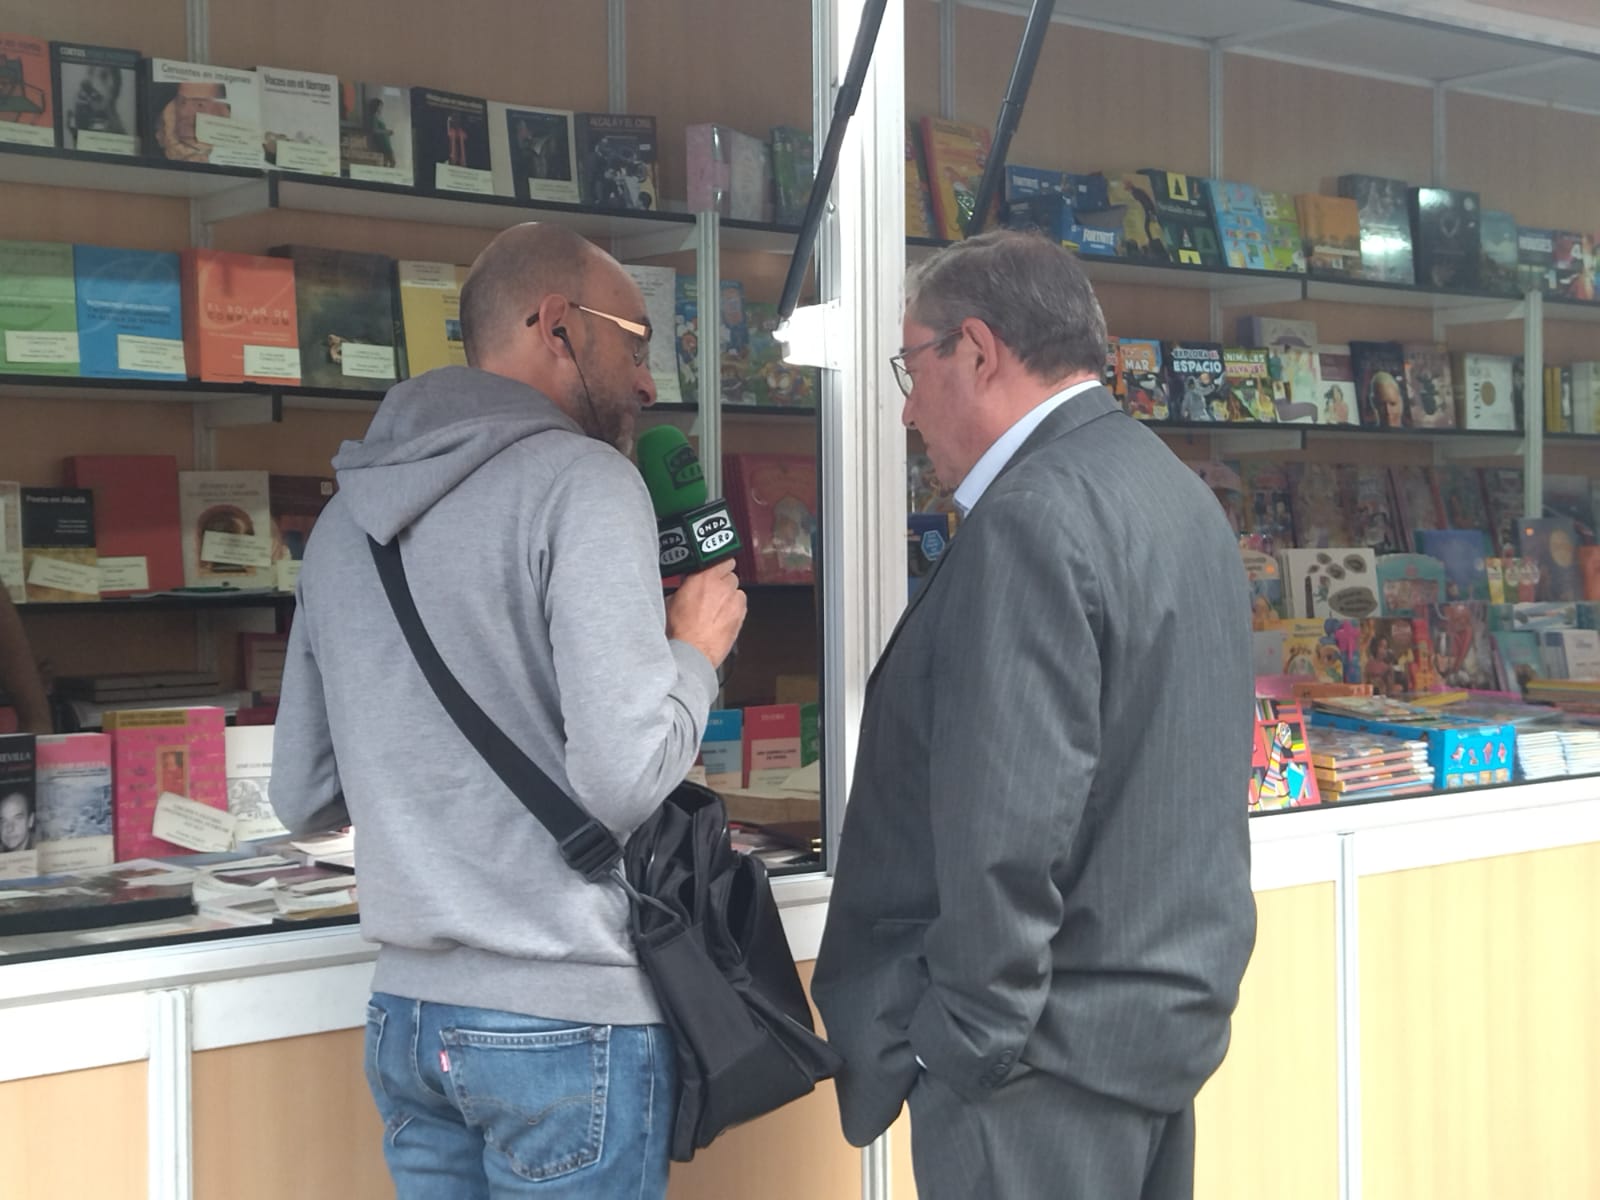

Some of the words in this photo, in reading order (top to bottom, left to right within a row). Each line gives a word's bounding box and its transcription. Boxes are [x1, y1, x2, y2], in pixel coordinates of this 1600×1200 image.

[207, 302, 221, 312] EL
[227, 304, 269, 316] SOLAR
[273, 309, 289, 319] DE
[207, 311, 289, 326] COMPLUTUM
[1224, 352, 1265, 363] ANIMALES
[1124, 359, 1149, 371] MAR
[1173, 360, 1222, 373] ESPACIO
[698, 519, 726, 536] ONDA
[705, 532, 730, 549] CERO
[662, 549, 686, 563] CERO
